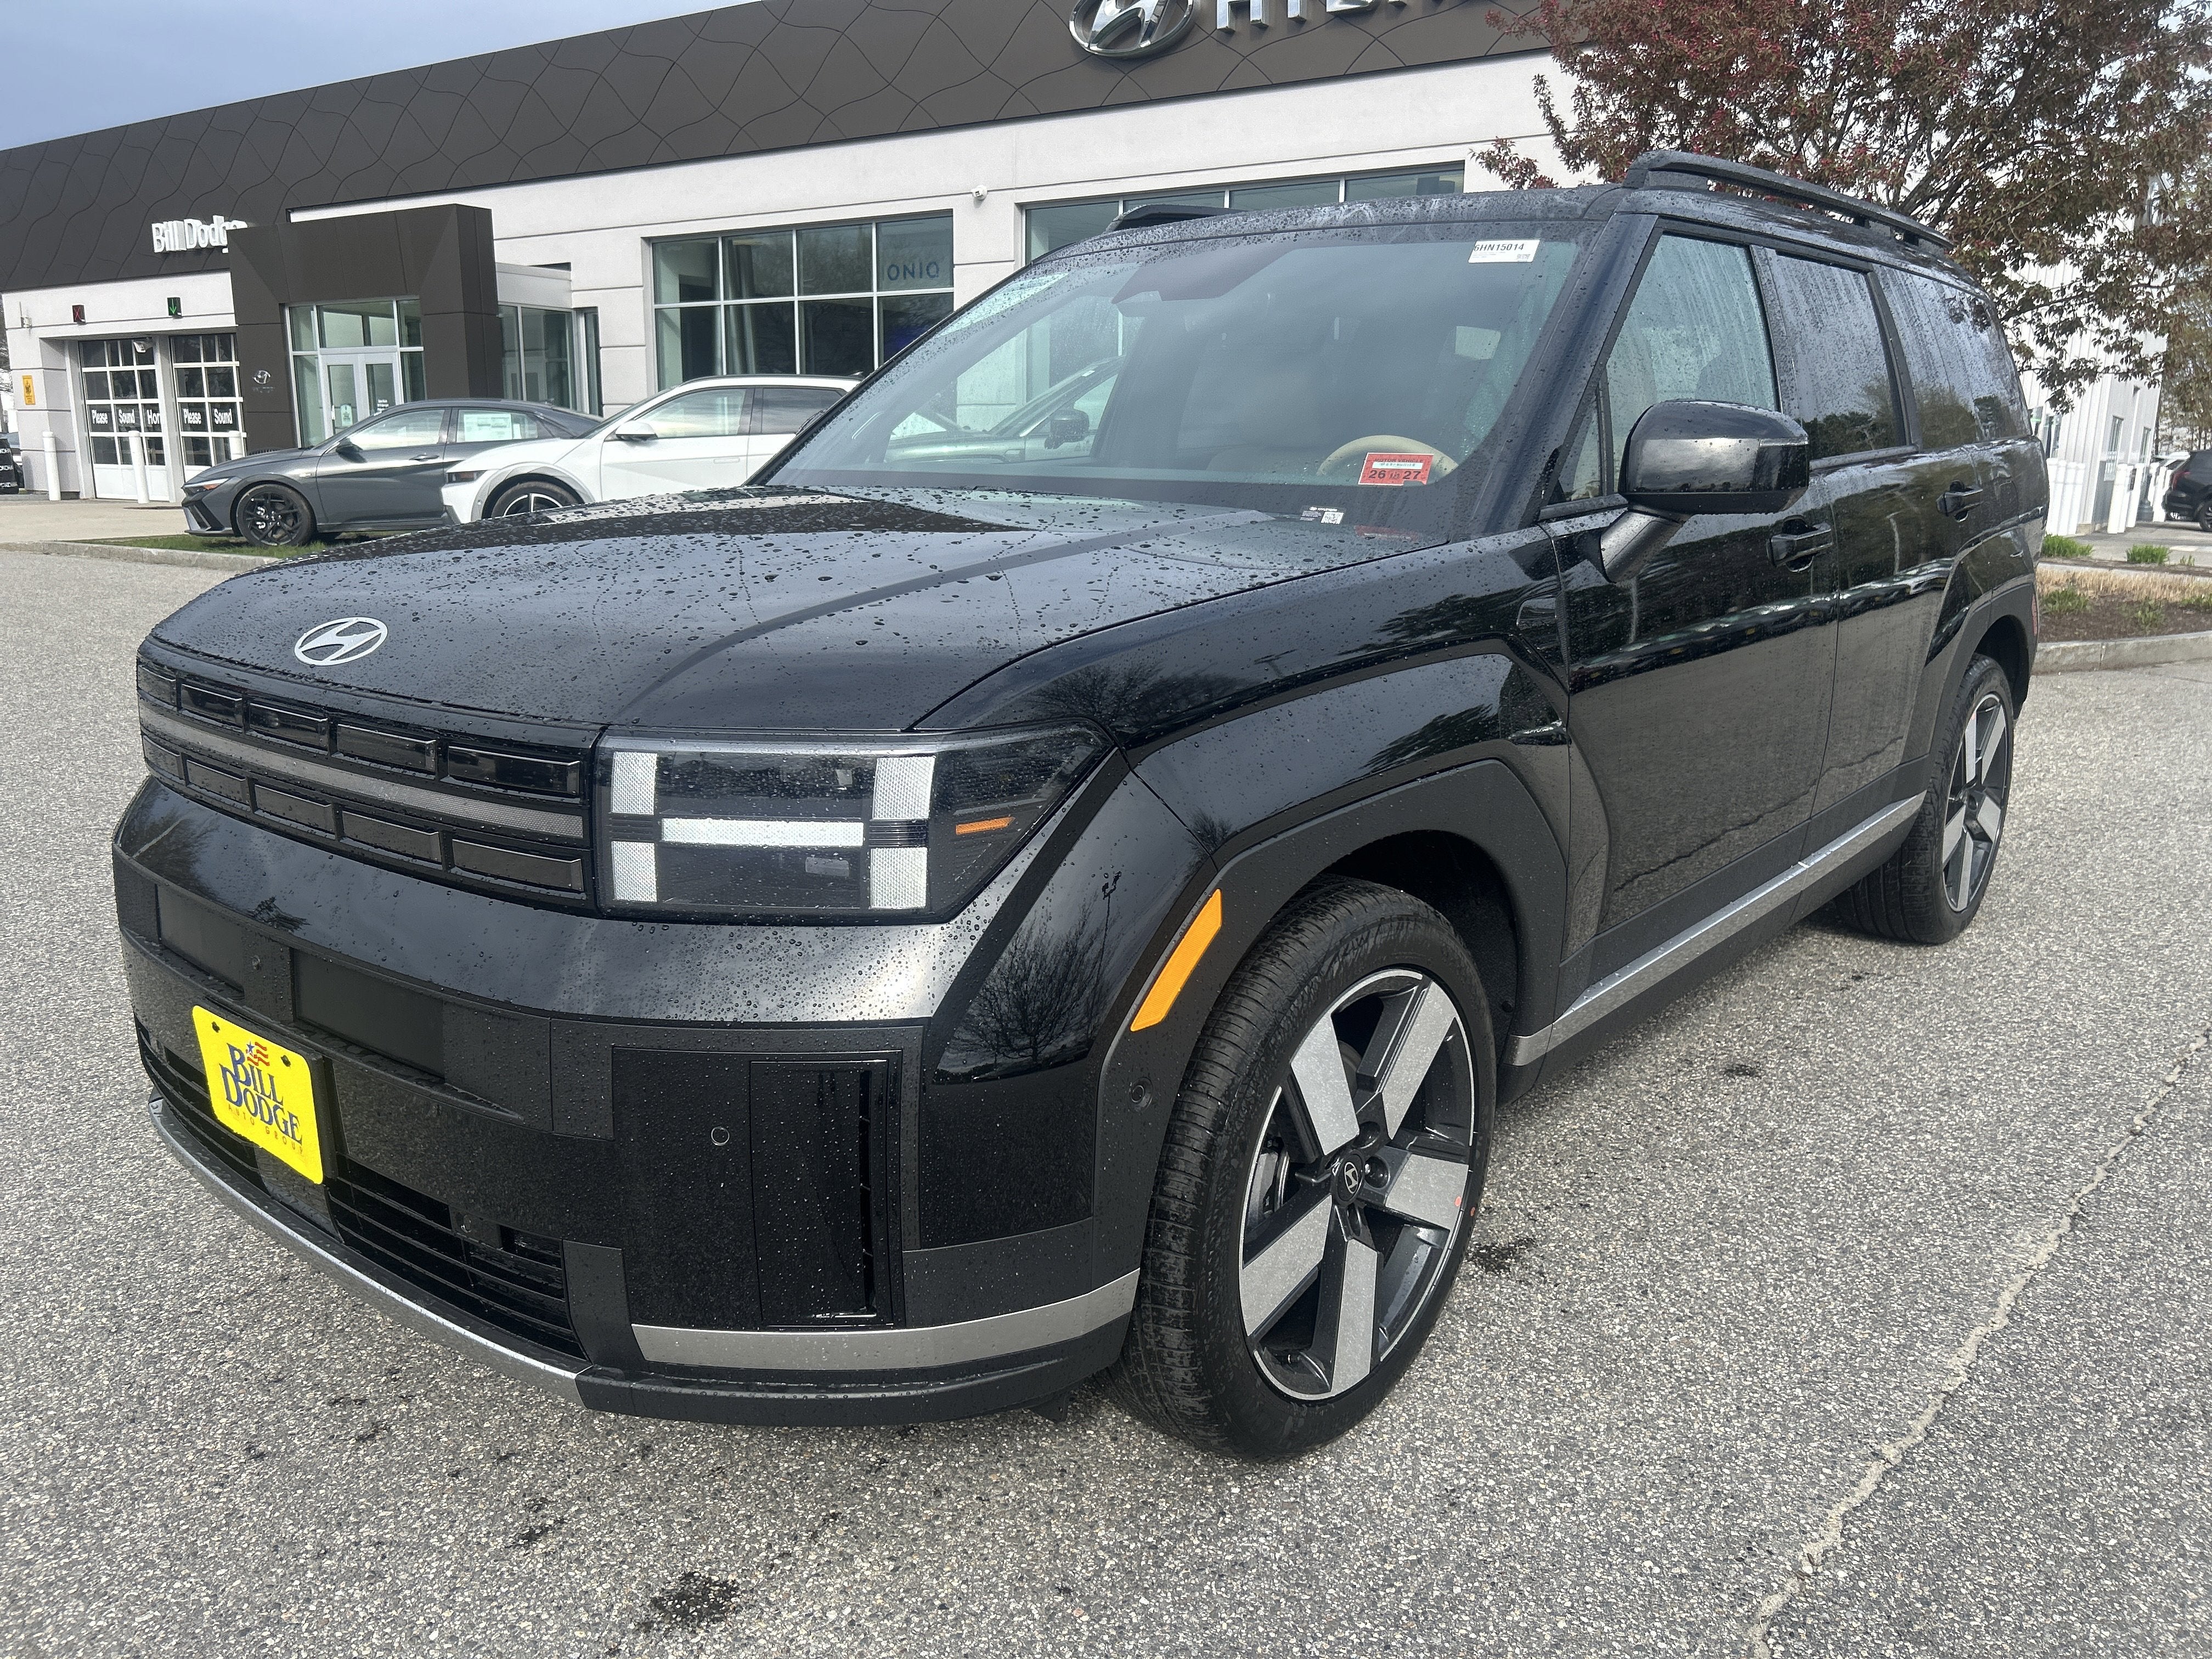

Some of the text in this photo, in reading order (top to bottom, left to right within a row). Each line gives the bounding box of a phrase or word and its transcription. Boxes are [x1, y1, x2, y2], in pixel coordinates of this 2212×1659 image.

[152, 215, 248, 253] Bill Dodg
[92, 409, 160, 425] Please Sound Hor
[183, 408, 233, 425] Please Sound
[1368, 470, 1386, 479] 26
[1402, 471, 1421, 479] 27
[226, 1042, 284, 1106] BILL
[219, 1063, 303, 1146] DODGE
